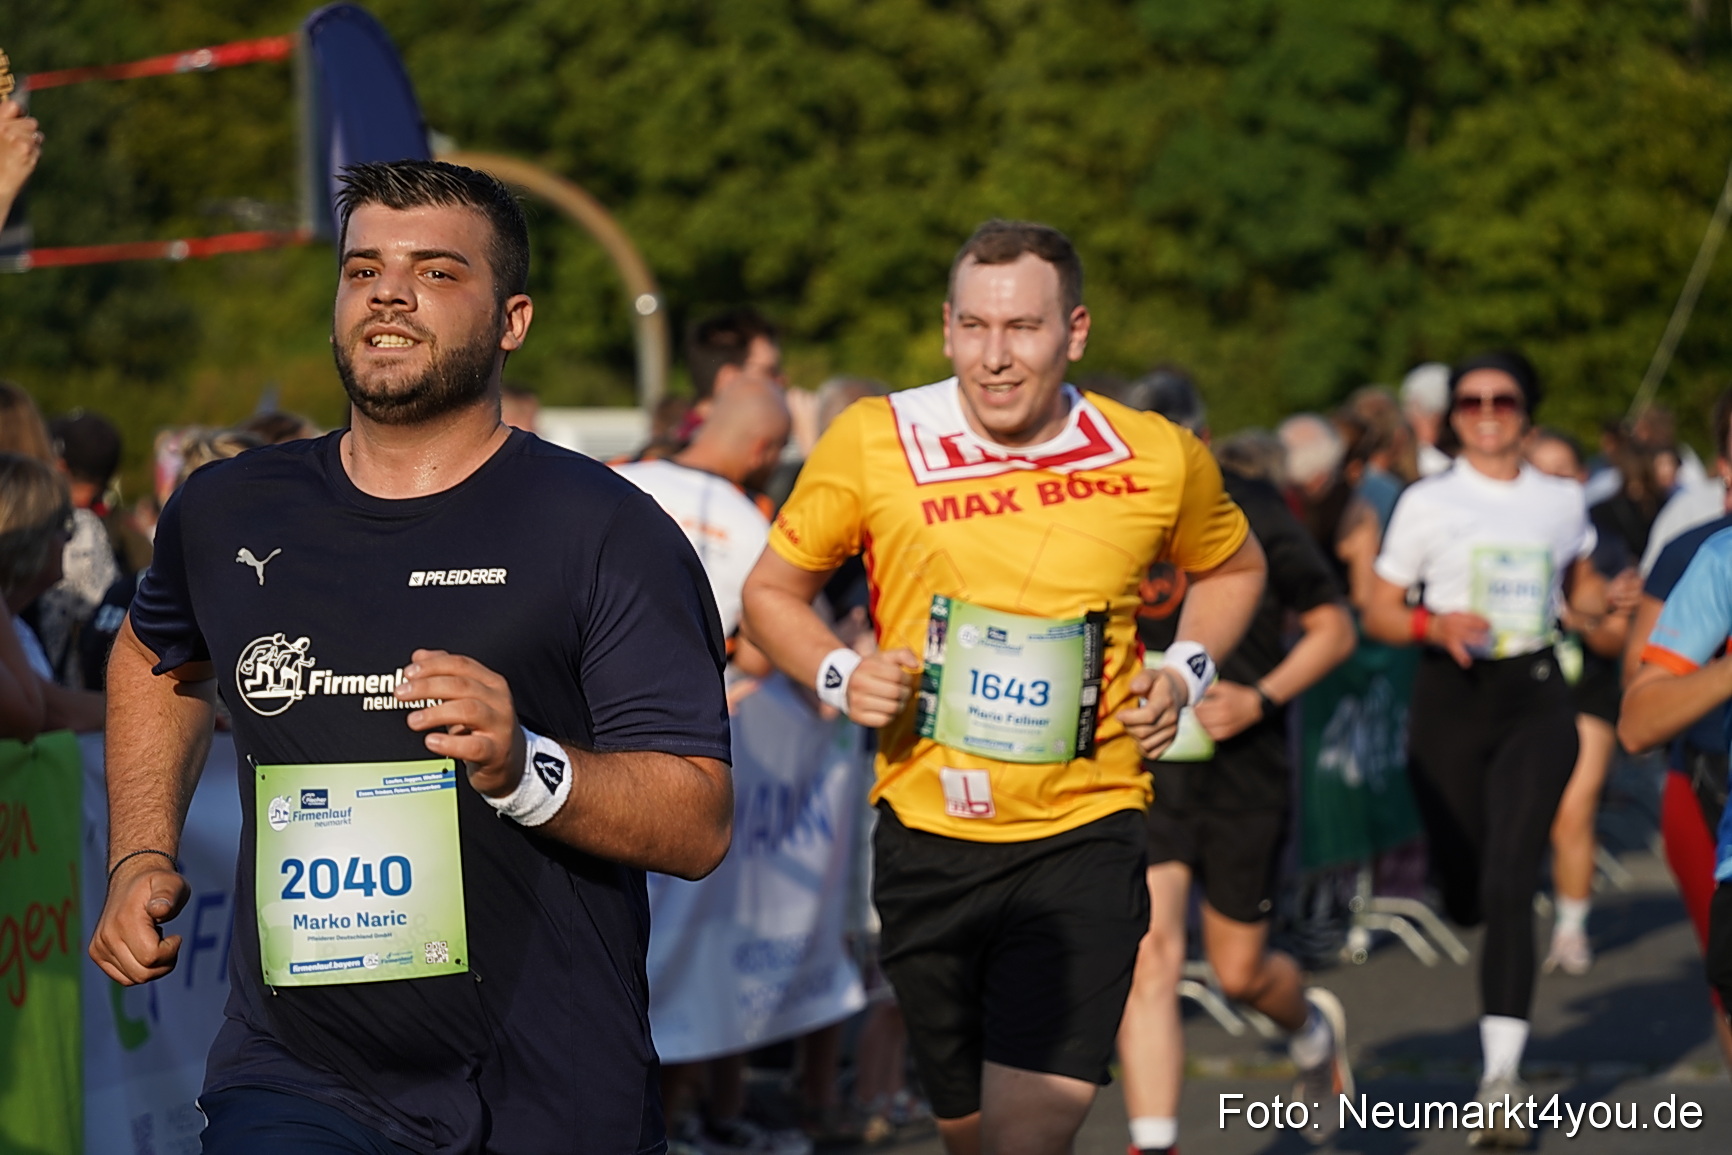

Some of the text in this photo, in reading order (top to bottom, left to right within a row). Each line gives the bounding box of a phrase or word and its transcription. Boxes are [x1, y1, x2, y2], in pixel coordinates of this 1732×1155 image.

[922, 488, 1023, 525] MAX
[424, 568, 507, 586] PFLEIDERER
[308, 668, 409, 695] Firmenl
[970, 669, 1051, 707] 1643
[292, 807, 352, 821] Firmenlauf
[314, 819, 352, 828] neumarkt
[281, 856, 412, 900] 2040
[293, 910, 407, 930] Marko Naric
[336, 933, 373, 941] Deutschland
